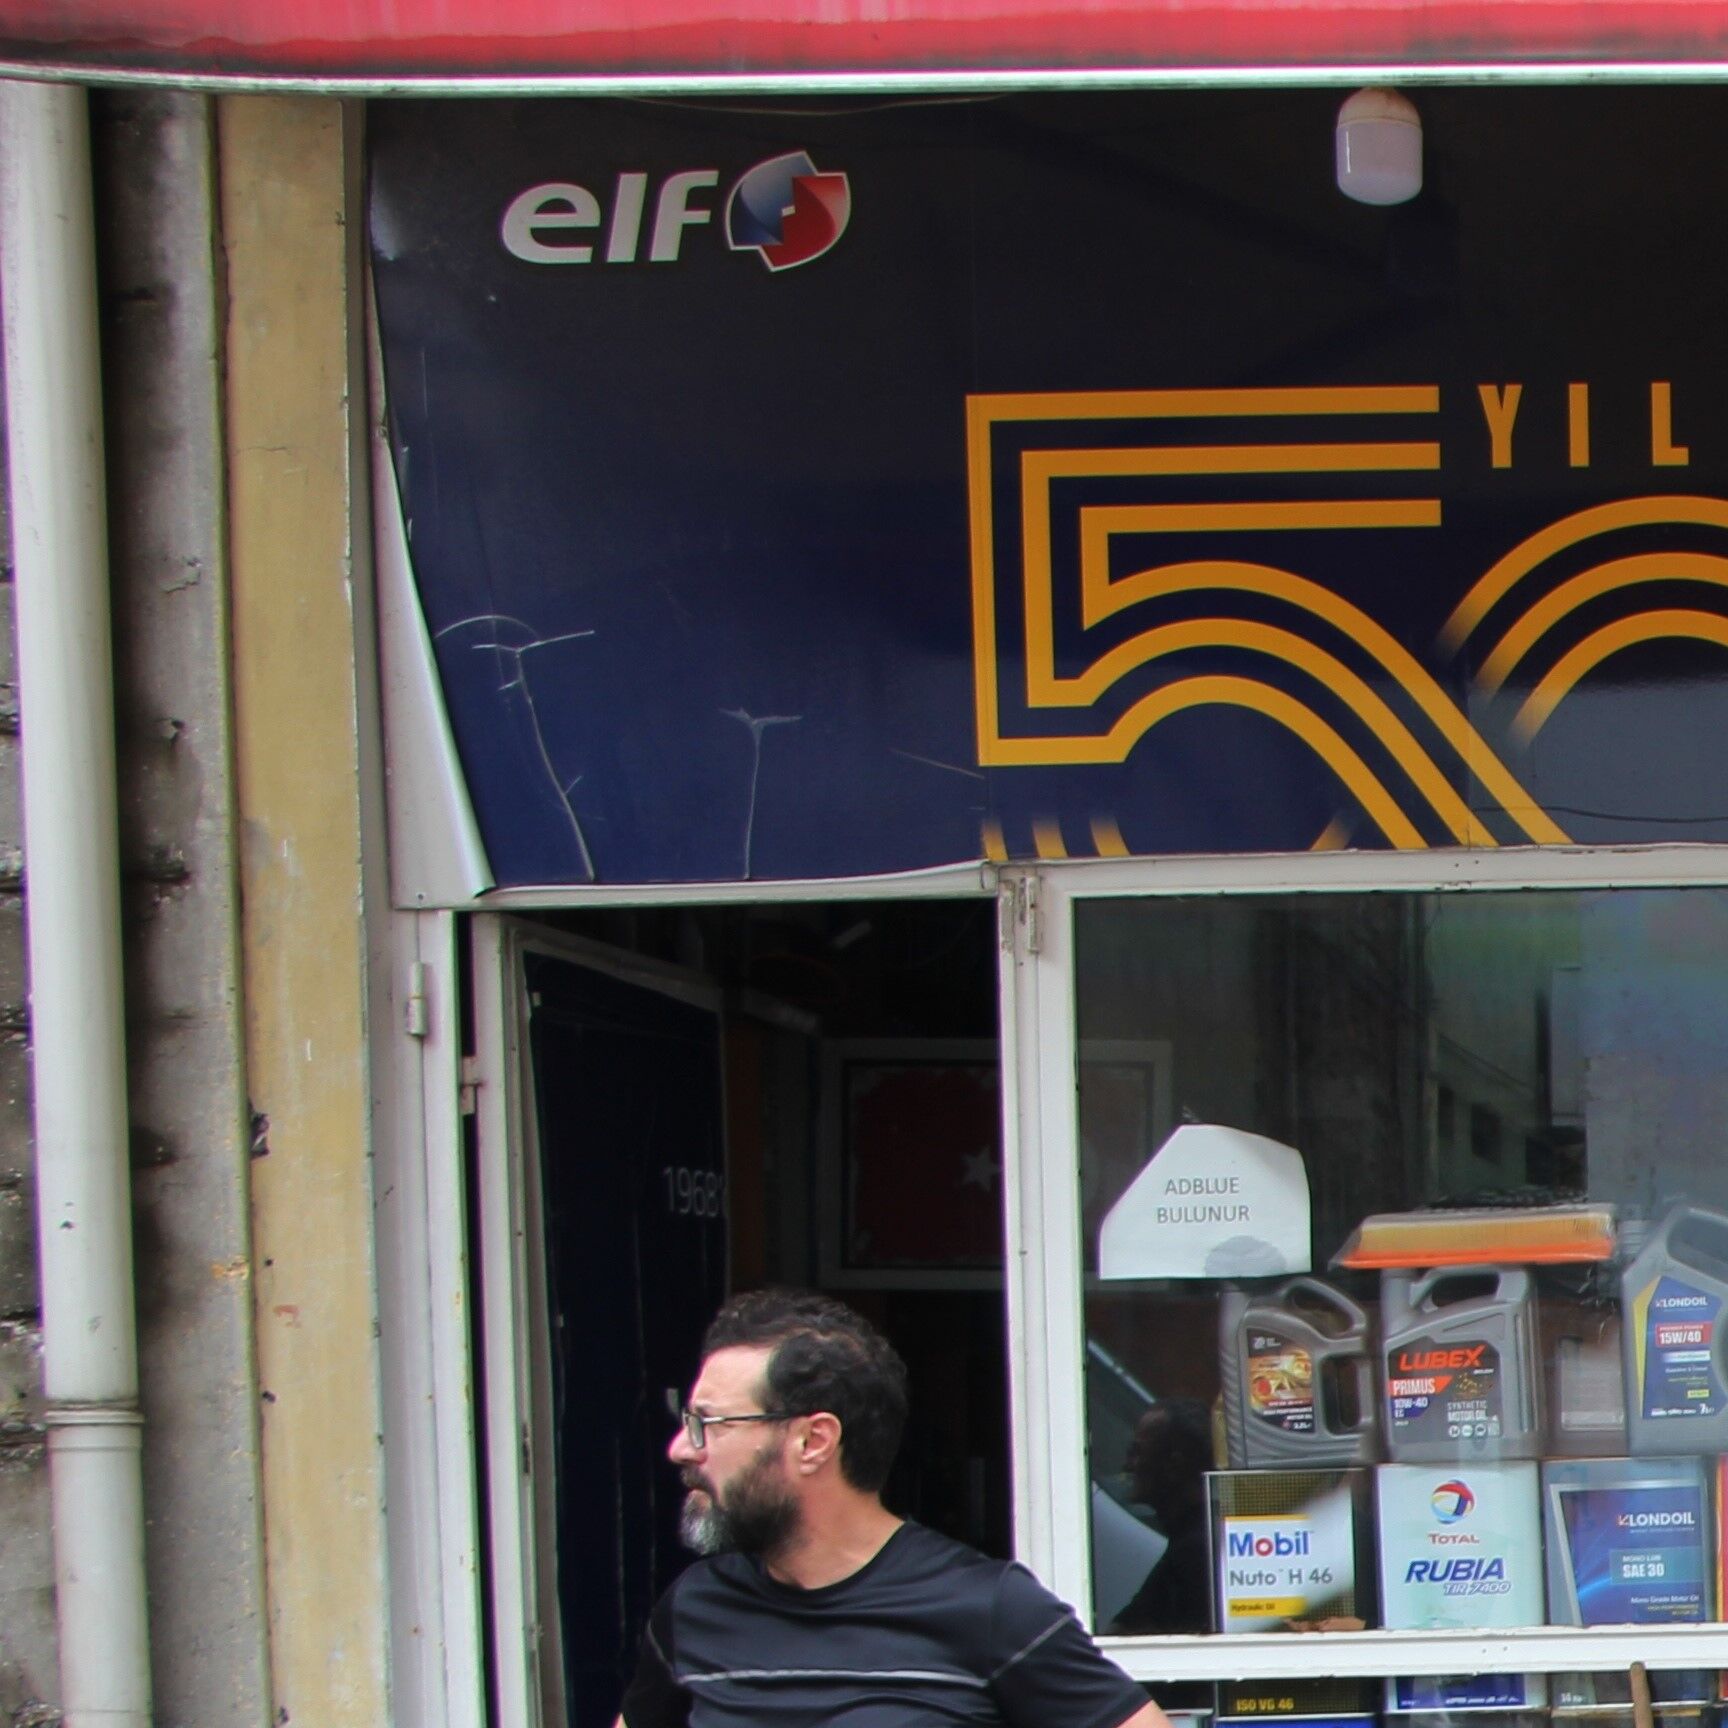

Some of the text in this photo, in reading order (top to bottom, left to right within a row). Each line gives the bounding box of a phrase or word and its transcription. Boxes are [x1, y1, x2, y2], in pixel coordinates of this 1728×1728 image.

[502, 169, 719, 264] elf
[1477, 382, 1690, 468] YIL
[1165, 1176, 1240, 1195] ADBLUE
[1156, 1205, 1250, 1225] BULUNUR
[1663, 1296, 1709, 1308] LONDOIL
[1659, 1330, 1702, 1345] 15W/40
[1400, 1344, 1486, 1372] LUBEX
[1393, 1378, 1436, 1396] PRIMUS
[1629, 1511, 1696, 1527] LONDOIL
[1228, 1531, 1310, 1557] Mobil
[1428, 1533, 1481, 1545] TOTAL
[1229, 1567, 1333, 1587] Nuto H 46
[1404, 1557, 1505, 1584] RUBIA
[1622, 1563, 1664, 1578] SAE 30
[1443, 1581, 1512, 1596] TIR 7400
[1236, 1698, 1257, 1712] ISO
[1259, 1698, 1276, 1711] VG
